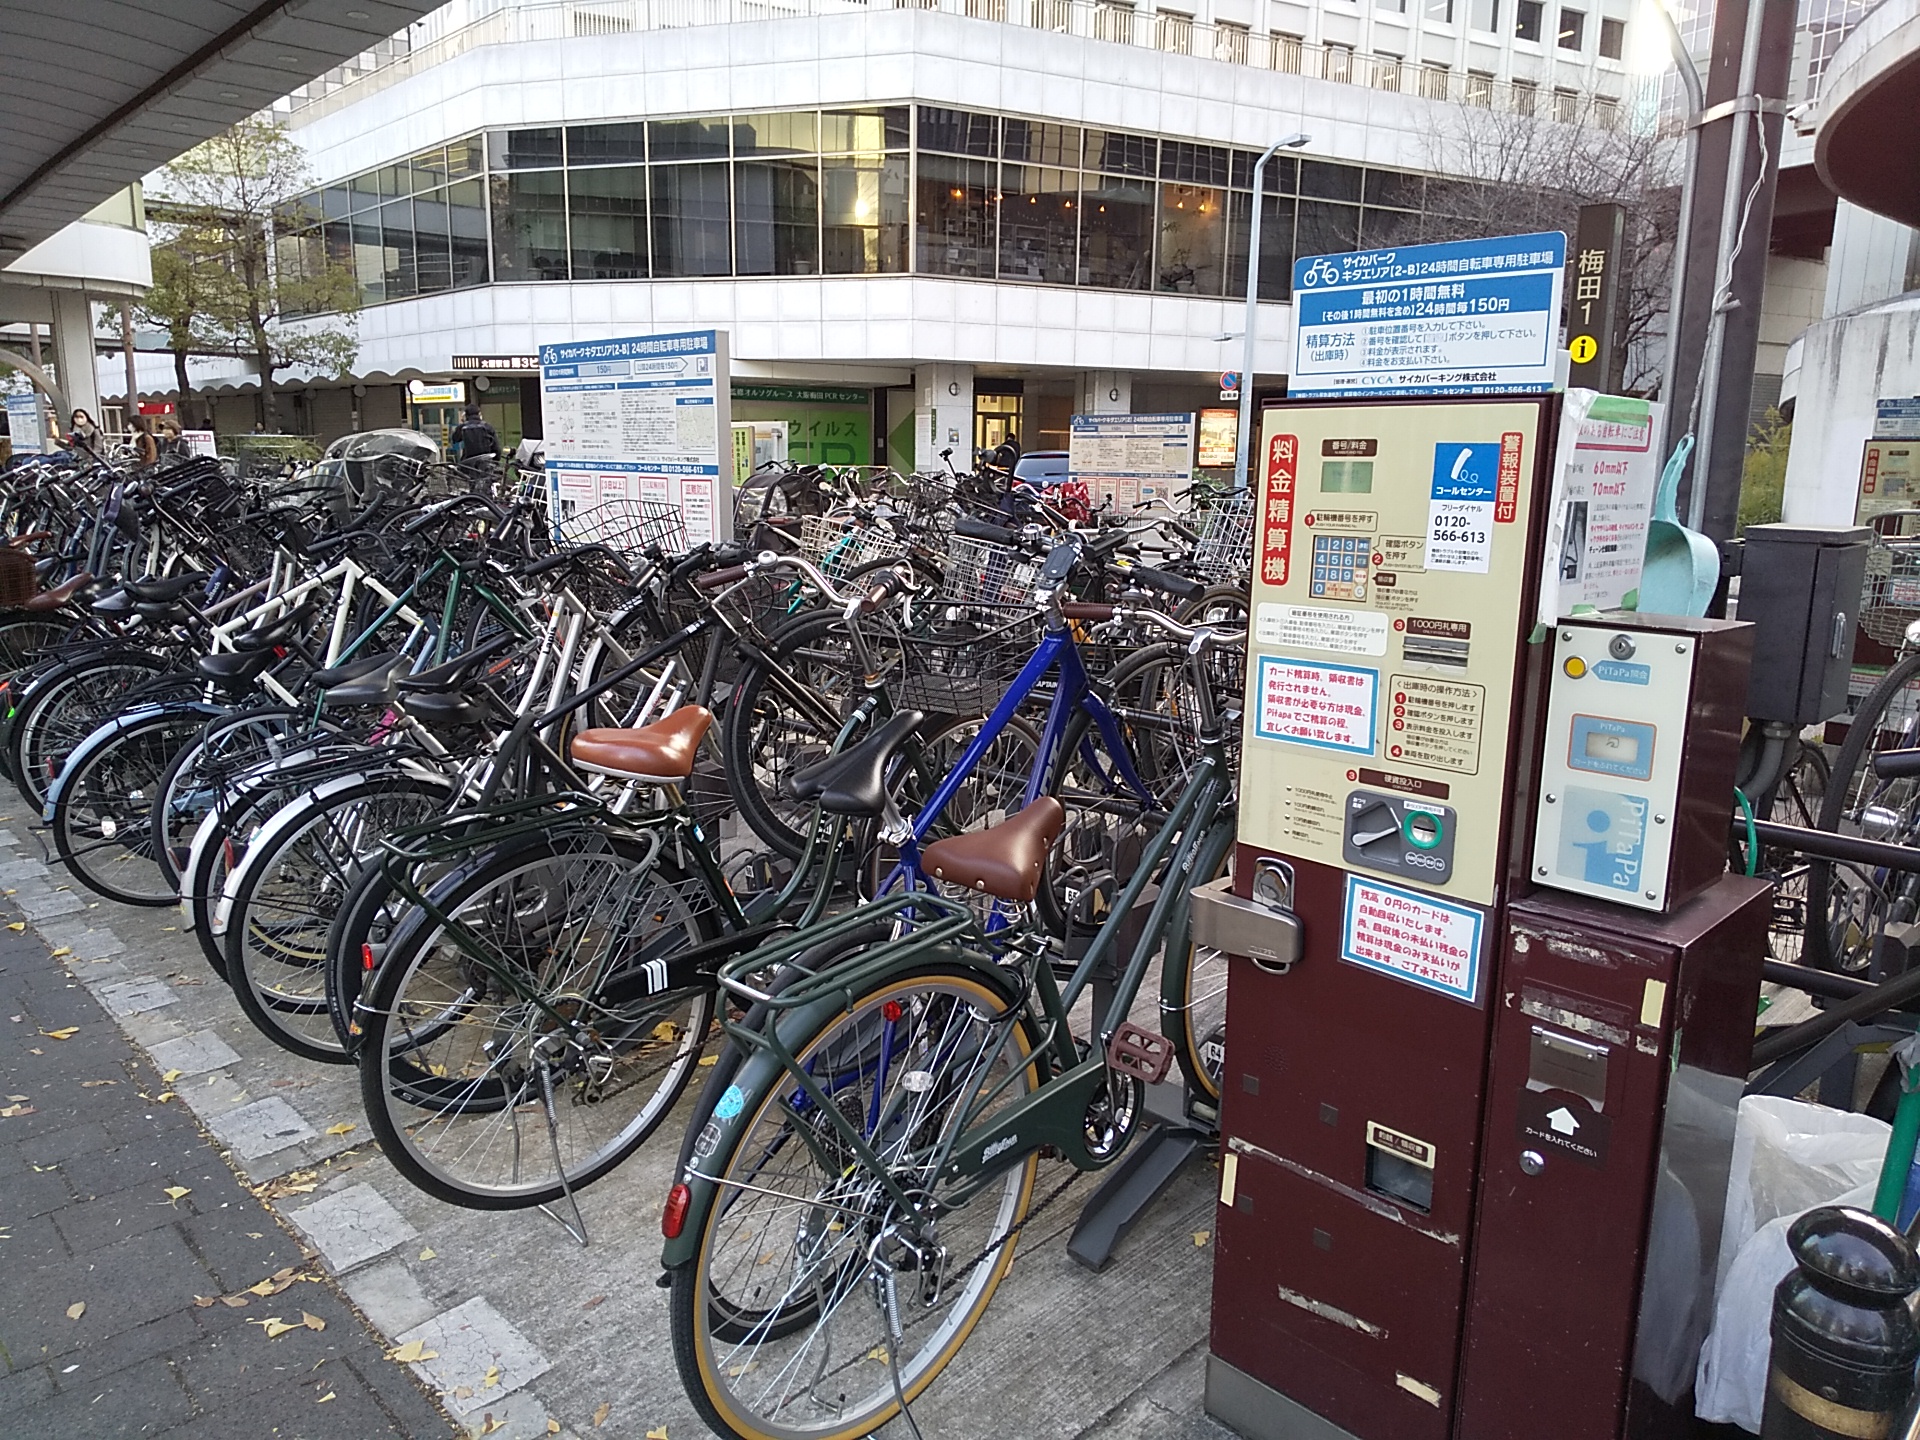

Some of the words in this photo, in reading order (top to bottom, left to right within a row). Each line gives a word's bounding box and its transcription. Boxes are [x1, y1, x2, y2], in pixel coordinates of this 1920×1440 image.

[1342, 253, 1396, 267] サイカパーク
[1361, 283, 1465, 305] 最初の1時間無料
[1577, 250, 1605, 325] 梅田1
[1305, 332, 1356, 349] 精算方法
[1362, 375, 1395, 385] CYCA
[1399, 371, 1497, 385] サイカパーキング株式会社
[1484, 385, 1542, 395] 0120-566-613
[1331, 440, 1368, 451] 番号/料金
[1593, 461, 1629, 475] 60mm以下
[1497, 434, 1522, 520] 警報装置付
[1435, 486, 1492, 497] コールセンター
[1263, 438, 1294, 582] 料金精算機
[1441, 504, 1483, 513] フリーダイヤル
[1316, 513, 1374, 525] 駐輪機番号を押す
[1434, 515, 1471, 528] 0120-
[1433, 529, 1486, 544] 566-613
[1332, 540, 1340, 550] 2
[1346, 540, 1353, 550] 3
[1385, 539, 1424, 549] 確認ボタン
[1317, 554, 1325, 564] 4
[1331, 555, 1338, 565] 5
[1345, 556, 1351, 566] 6
[1384, 551, 1407, 560] を押す
[1317, 569, 1324, 578] 7
[1330, 570, 1337, 580] 8
[1344, 571, 1350, 580] 9
[1315, 583, 1323, 593] 0
[1411, 620, 1467, 632] 1000円札専用
[1268, 680, 1331, 697] 発行されません。
[1600, 723, 1625, 733] PiTaPa
[1384, 774, 1422, 788] 硬貨投入口
[1612, 800, 1646, 887] PiTaPa
[1360, 889, 1379, 903] 残高
[1358, 904, 1448, 938] 自動回収いたします。
[1357, 917, 1469, 959] 尚、回収後の未払い残金の
[1356, 931, 1461, 971] 精算は現金のみ支払いが
[1211, 1045, 1221, 1059] 64
[1524, 1126, 1598, 1158] カードを入れてください
